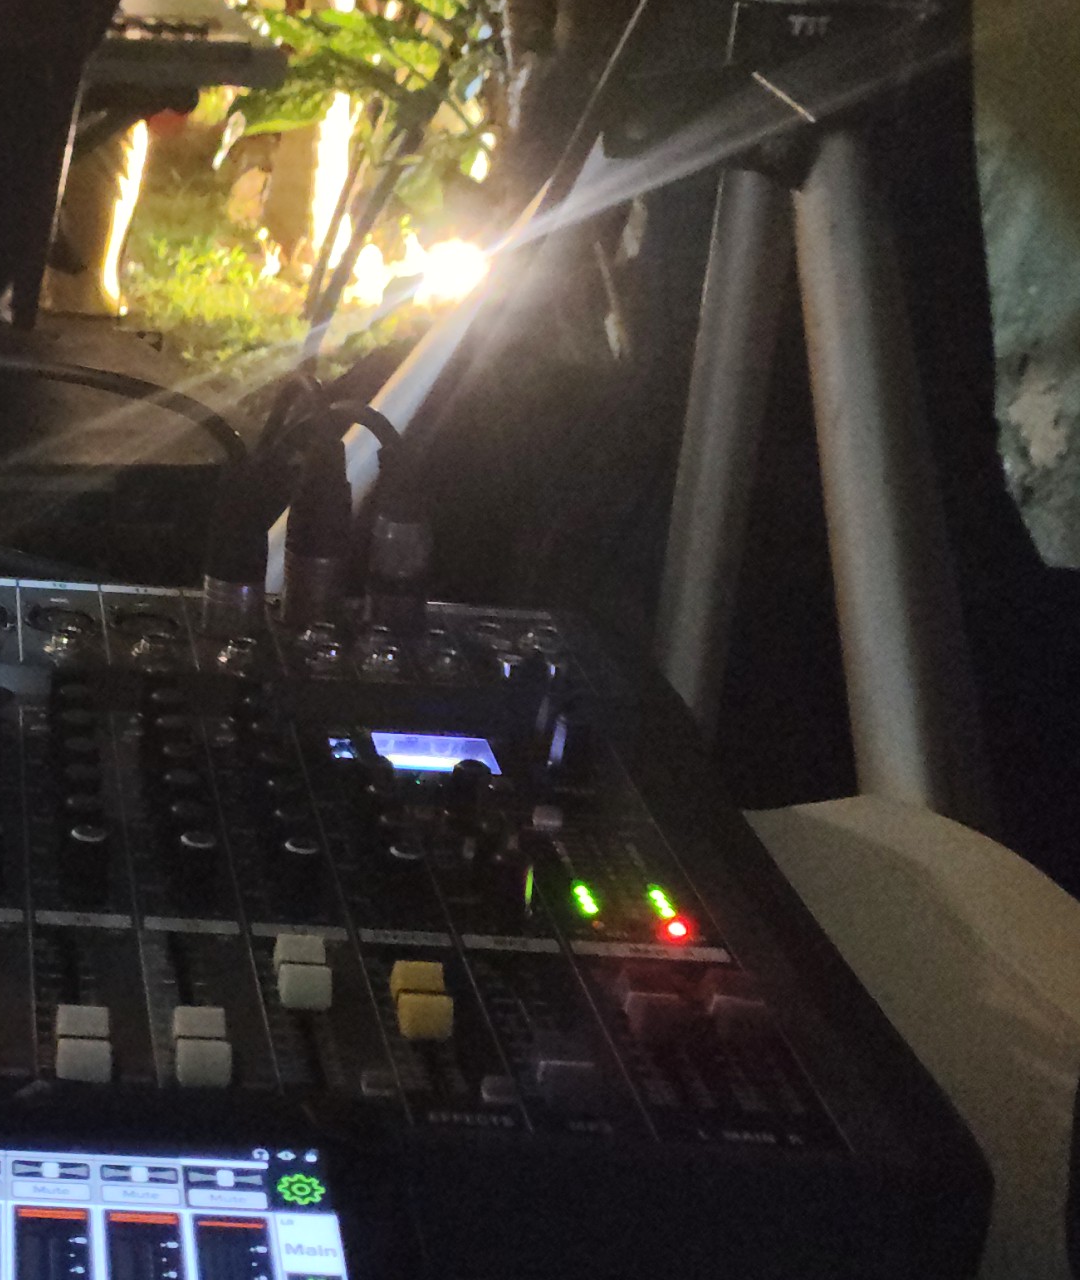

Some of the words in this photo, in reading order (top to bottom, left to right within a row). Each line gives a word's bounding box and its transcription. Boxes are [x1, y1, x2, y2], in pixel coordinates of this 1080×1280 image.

[33, 1184, 70, 1196] Mute
[122, 1188, 160, 1200] Mute
[284, 1242, 338, 1258] Main
